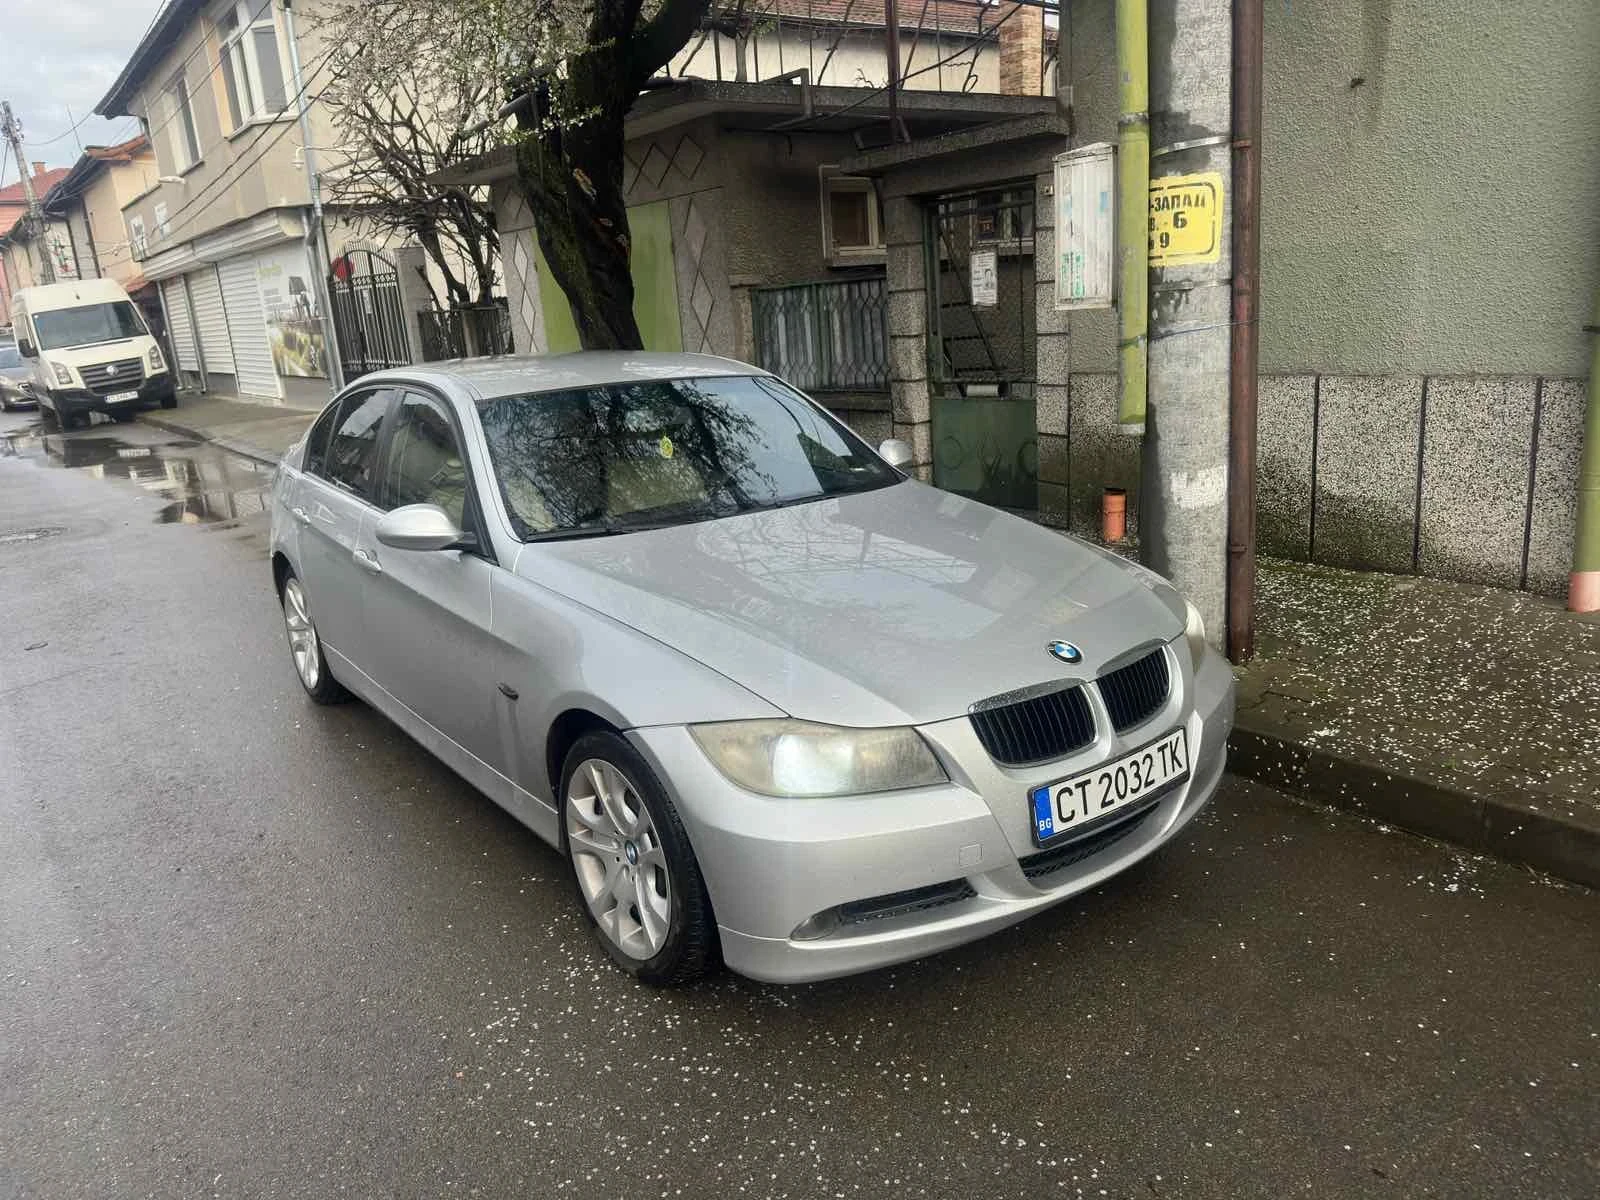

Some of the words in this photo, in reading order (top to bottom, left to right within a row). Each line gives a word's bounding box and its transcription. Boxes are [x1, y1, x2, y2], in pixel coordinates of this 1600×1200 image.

[1160, 232, 1170, 249] 9
[1056, 779, 1091, 823] CT
[1098, 753, 1155, 810] 2032
[1157, 736, 1183, 778] TK
[1039, 817, 1052, 831] BG
